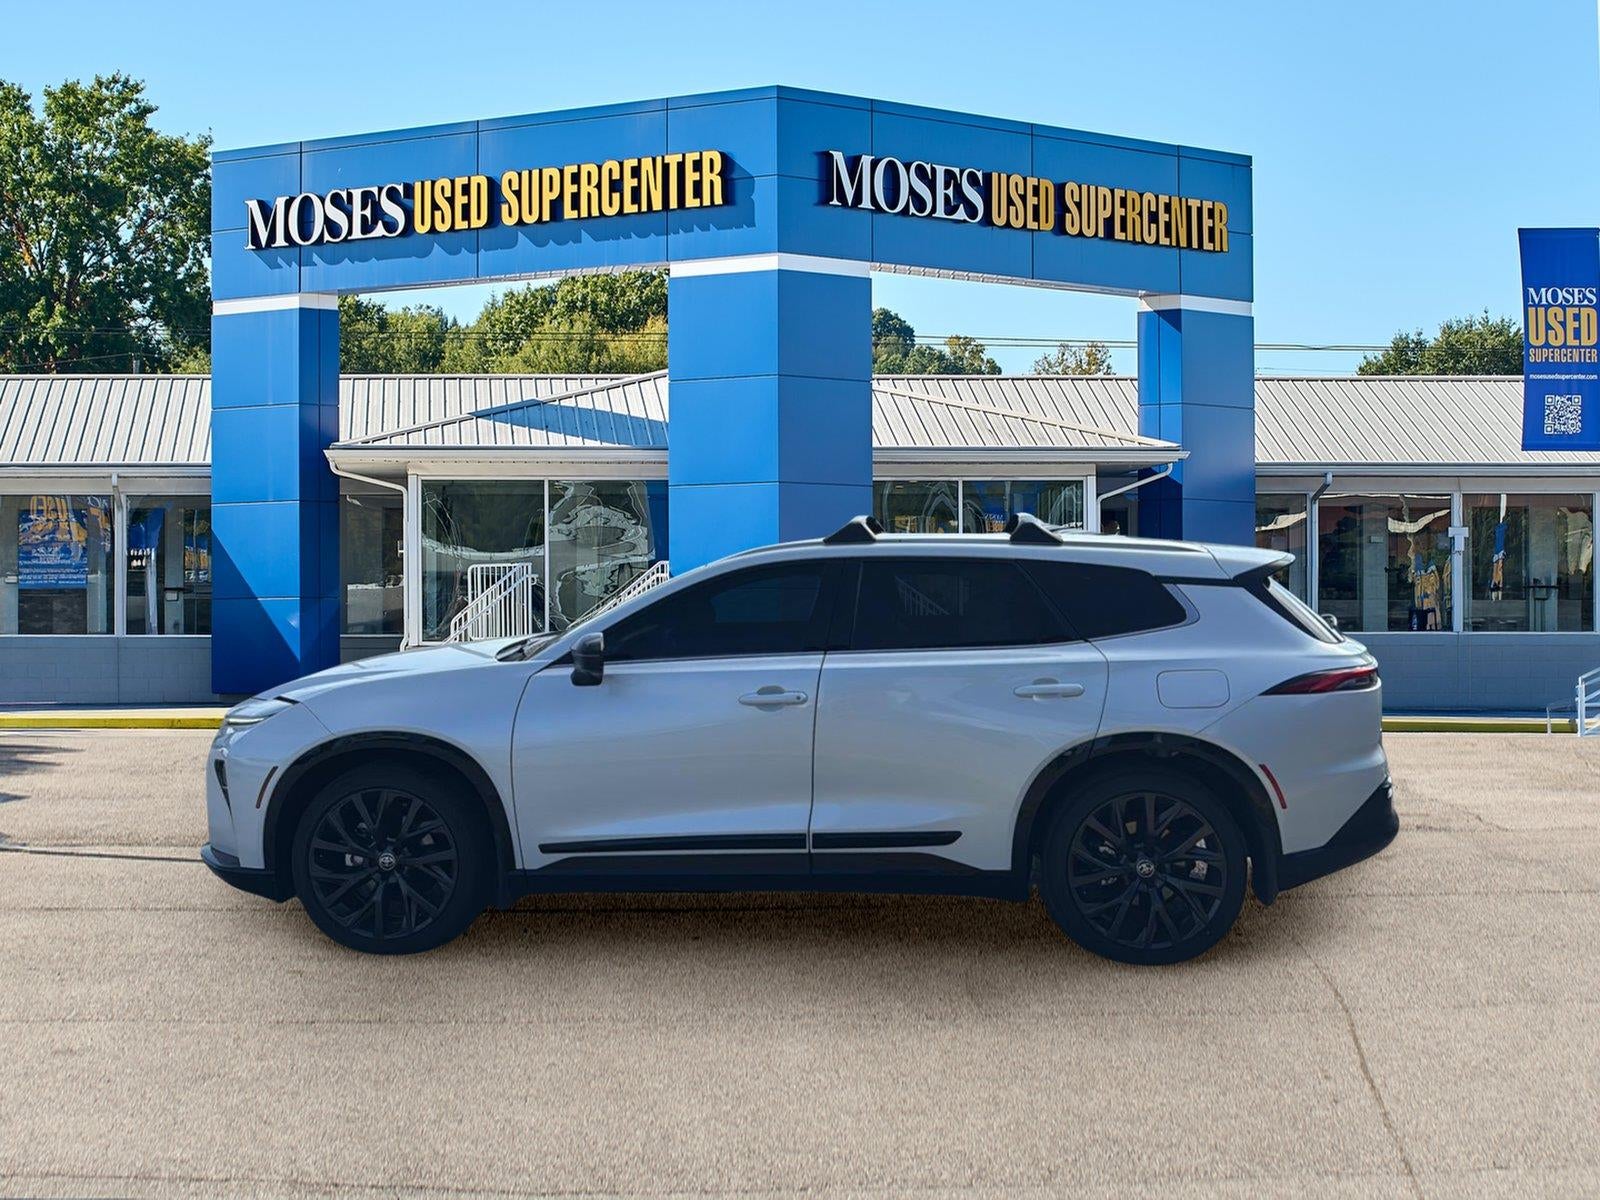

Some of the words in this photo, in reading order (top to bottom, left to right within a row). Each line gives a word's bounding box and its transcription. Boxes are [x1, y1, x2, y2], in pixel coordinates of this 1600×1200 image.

[245, 183, 406, 250] MOSES
[413, 176, 489, 234] USED
[500, 150, 724, 227] SUPERCENTER
[829, 150, 985, 223] MOSES
[991, 172, 1055, 231] USED
[1064, 181, 1230, 252] SUPERCENTER
[1527, 287, 1597, 305] MOSES
[1528, 307, 1598, 347] USED
[1529, 348, 1598, 363] SUPERCENTER
[1529, 373, 1598, 381] mosesusedsupercenter.com
